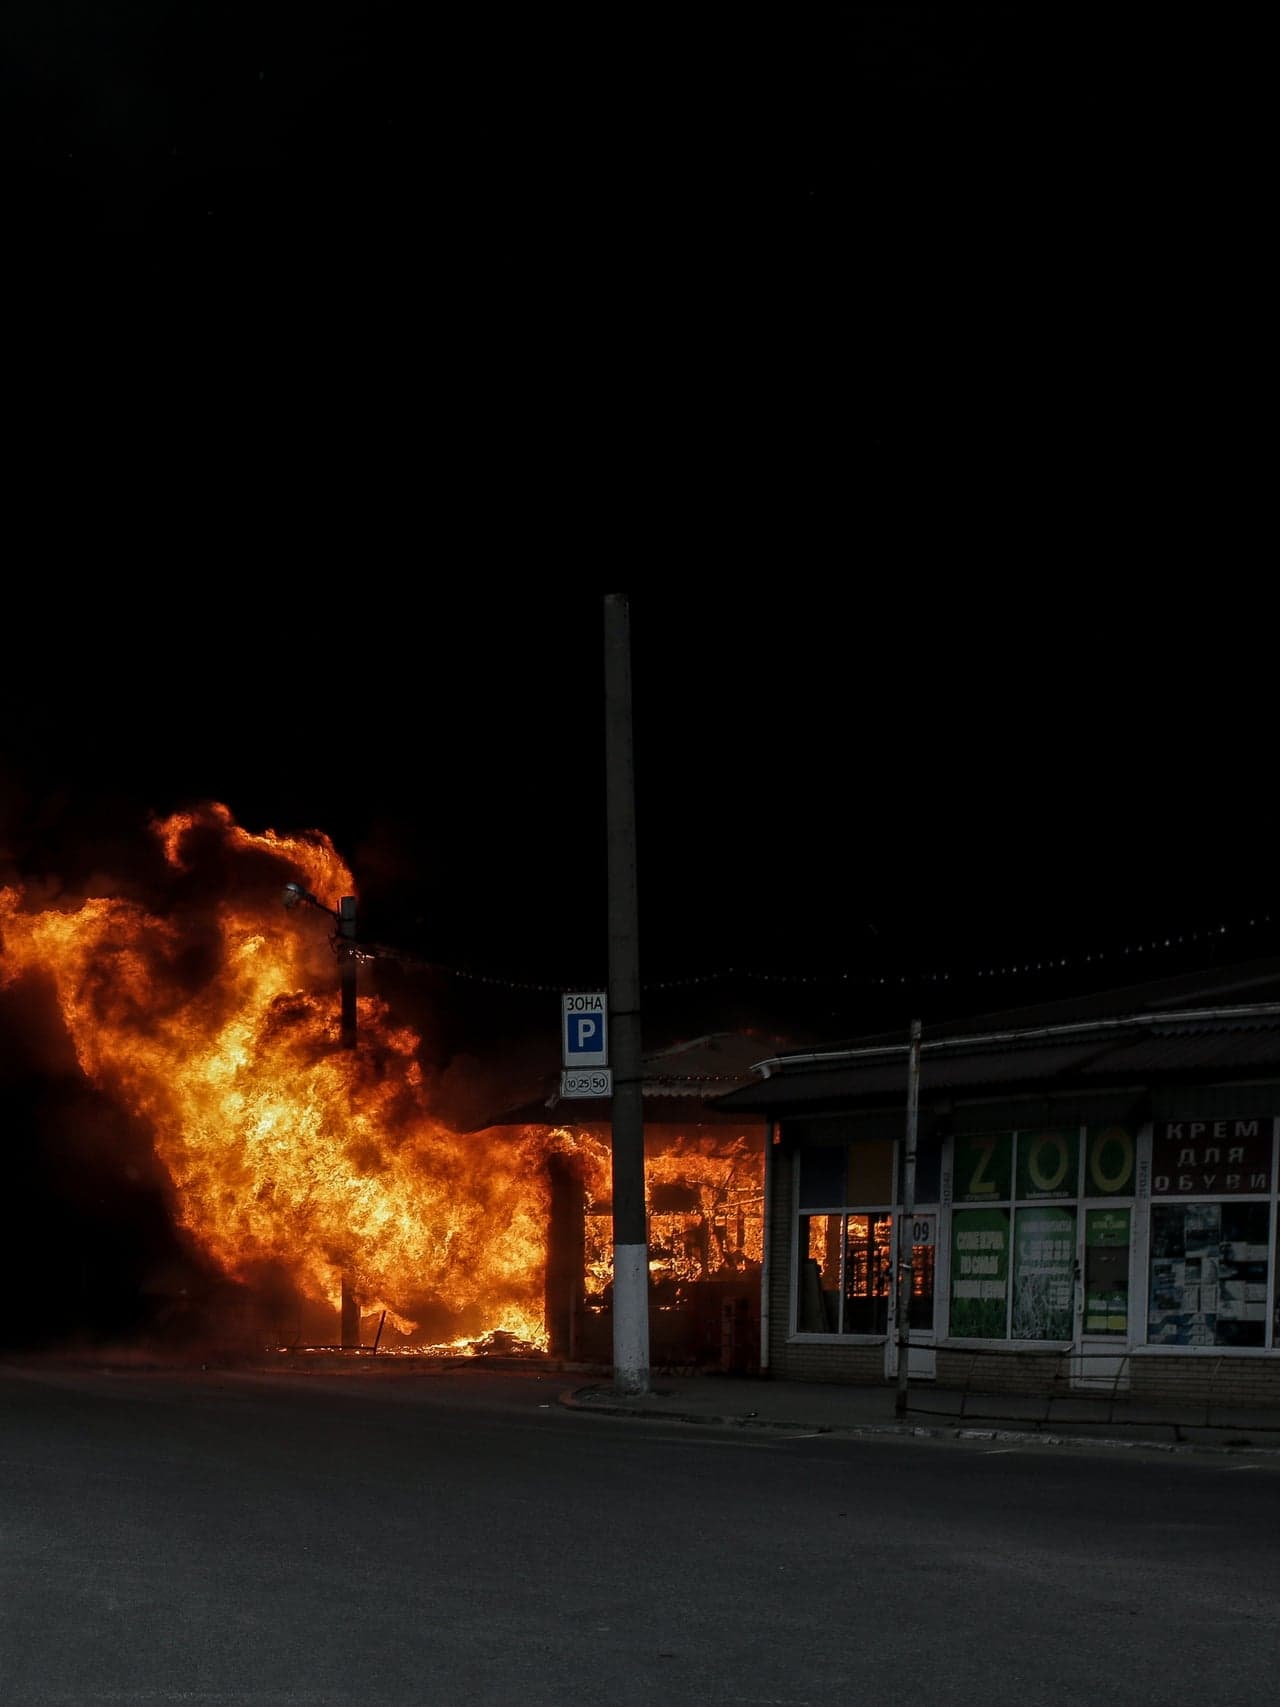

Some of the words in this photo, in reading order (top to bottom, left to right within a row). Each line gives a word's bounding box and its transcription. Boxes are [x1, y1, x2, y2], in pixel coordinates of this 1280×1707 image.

[567, 997, 602, 1011] ЗОНА
[577, 1018, 596, 1047] P
[567, 1080, 576, 1088] 10
[579, 1080, 589, 1088] 25
[593, 1078, 605, 1088] 50
[1166, 1120, 1260, 1140] КРЕМ
[968, 1126, 1134, 1193] ZOO
[1177, 1146, 1248, 1167] ДЛЯ
[1154, 1173, 1267, 1191] ОБУВИ
